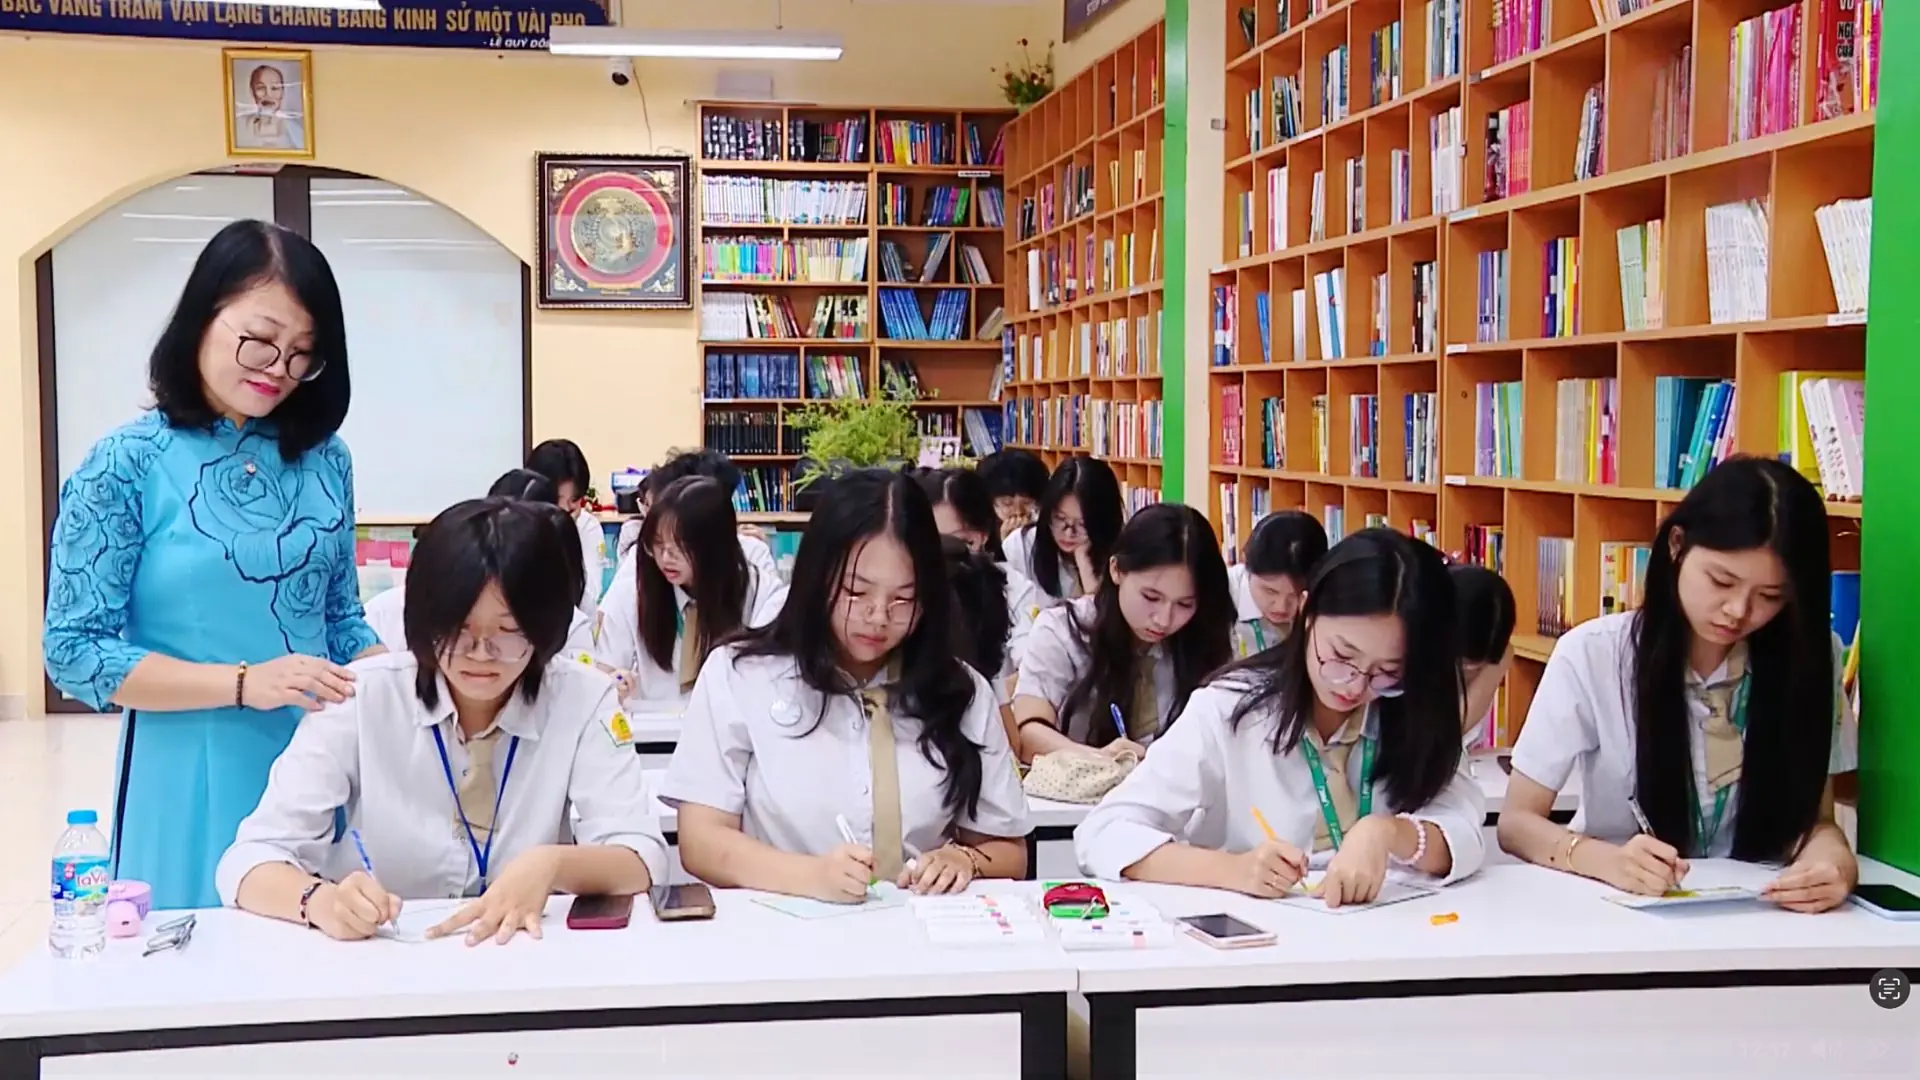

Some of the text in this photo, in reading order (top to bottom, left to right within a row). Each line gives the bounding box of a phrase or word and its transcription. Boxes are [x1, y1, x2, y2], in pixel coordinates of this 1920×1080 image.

[393, 8, 437, 30] KINH
[475, 6, 513, 36] MỘT
[517, 7, 546, 34] VÀI
